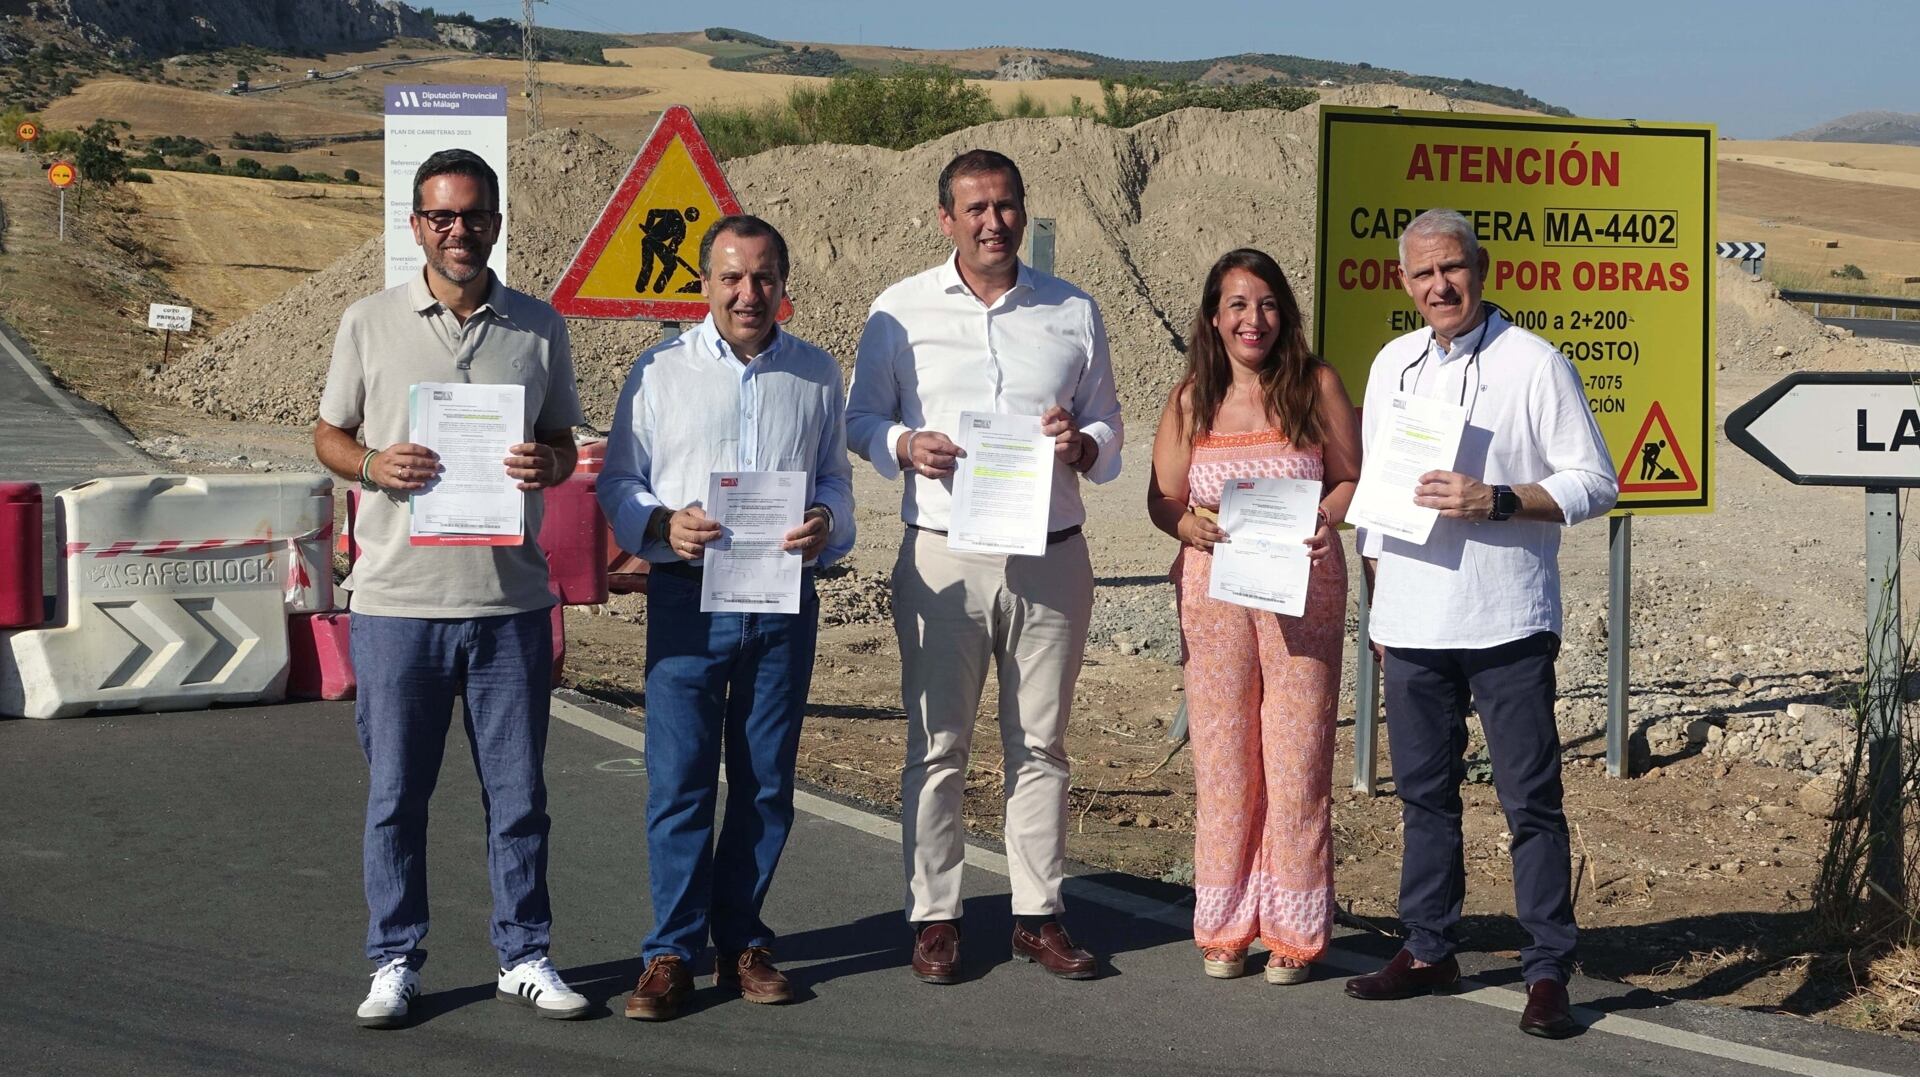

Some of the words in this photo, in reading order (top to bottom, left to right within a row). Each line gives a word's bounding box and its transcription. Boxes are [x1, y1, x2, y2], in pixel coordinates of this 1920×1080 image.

[422, 91, 461, 100] Diputación
[462, 92, 498, 100] Provincial
[433, 100, 460, 110] Málaga
[1406, 141, 1620, 187] ATENCIÓN
[1350, 207, 1535, 241] CARERA
[1546, 212, 1676, 244] MA-4402
[1496, 260, 1561, 291] POR
[1572, 261, 1690, 292] OBRAS
[1553, 314, 1564, 330] a
[1570, 310, 1627, 330] 2+200
[1551, 341, 1639, 366] GOSTO)
[1580, 375, 1622, 390] -7075
[1857, 409, 1920, 452] LA
